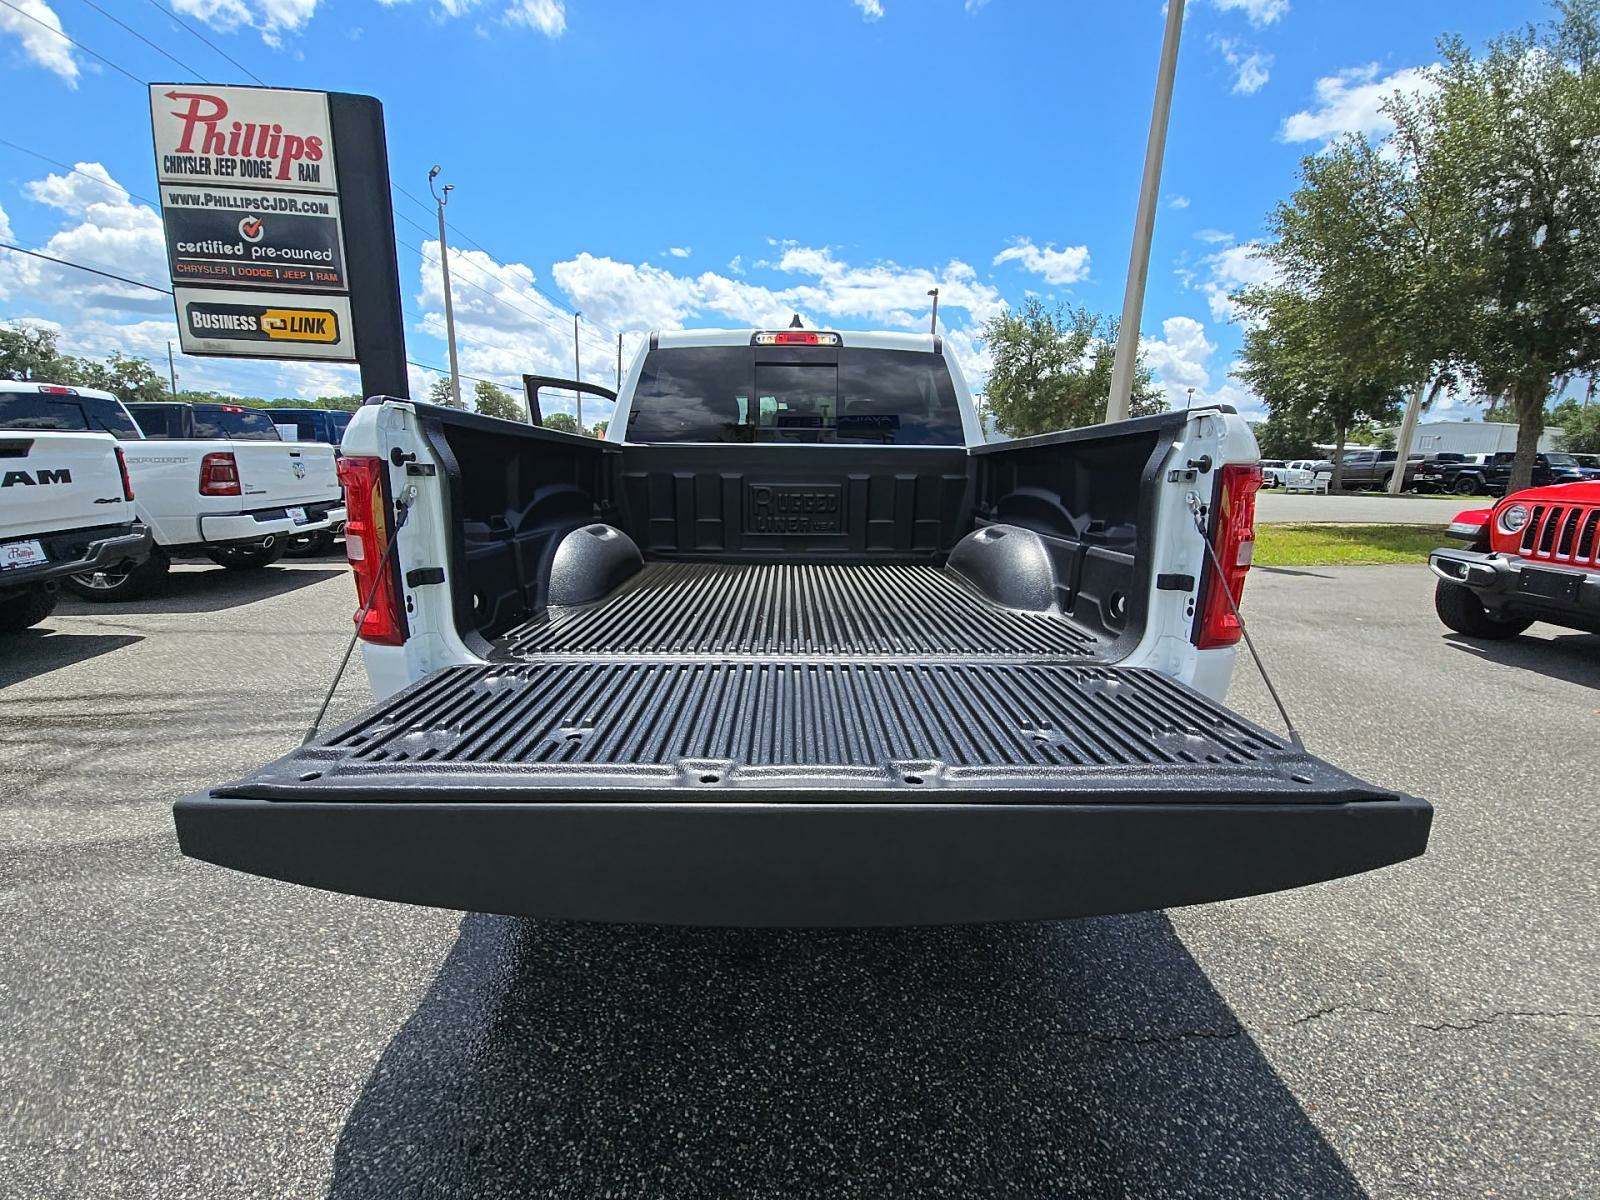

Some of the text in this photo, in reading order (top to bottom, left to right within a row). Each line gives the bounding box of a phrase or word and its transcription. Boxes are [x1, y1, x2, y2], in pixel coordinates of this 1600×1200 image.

[164, 90, 323, 180] Phillips
[164, 155, 320, 182] CHRYSLER JEEP DODGE RAM
[177, 240, 332, 261] certified pre-owned
[176, 264, 338, 281] CHRYSLER DODGE JEEP RAM
[191, 311, 326, 334] BUSINESS LINK
[1, 469, 72, 487] AM
